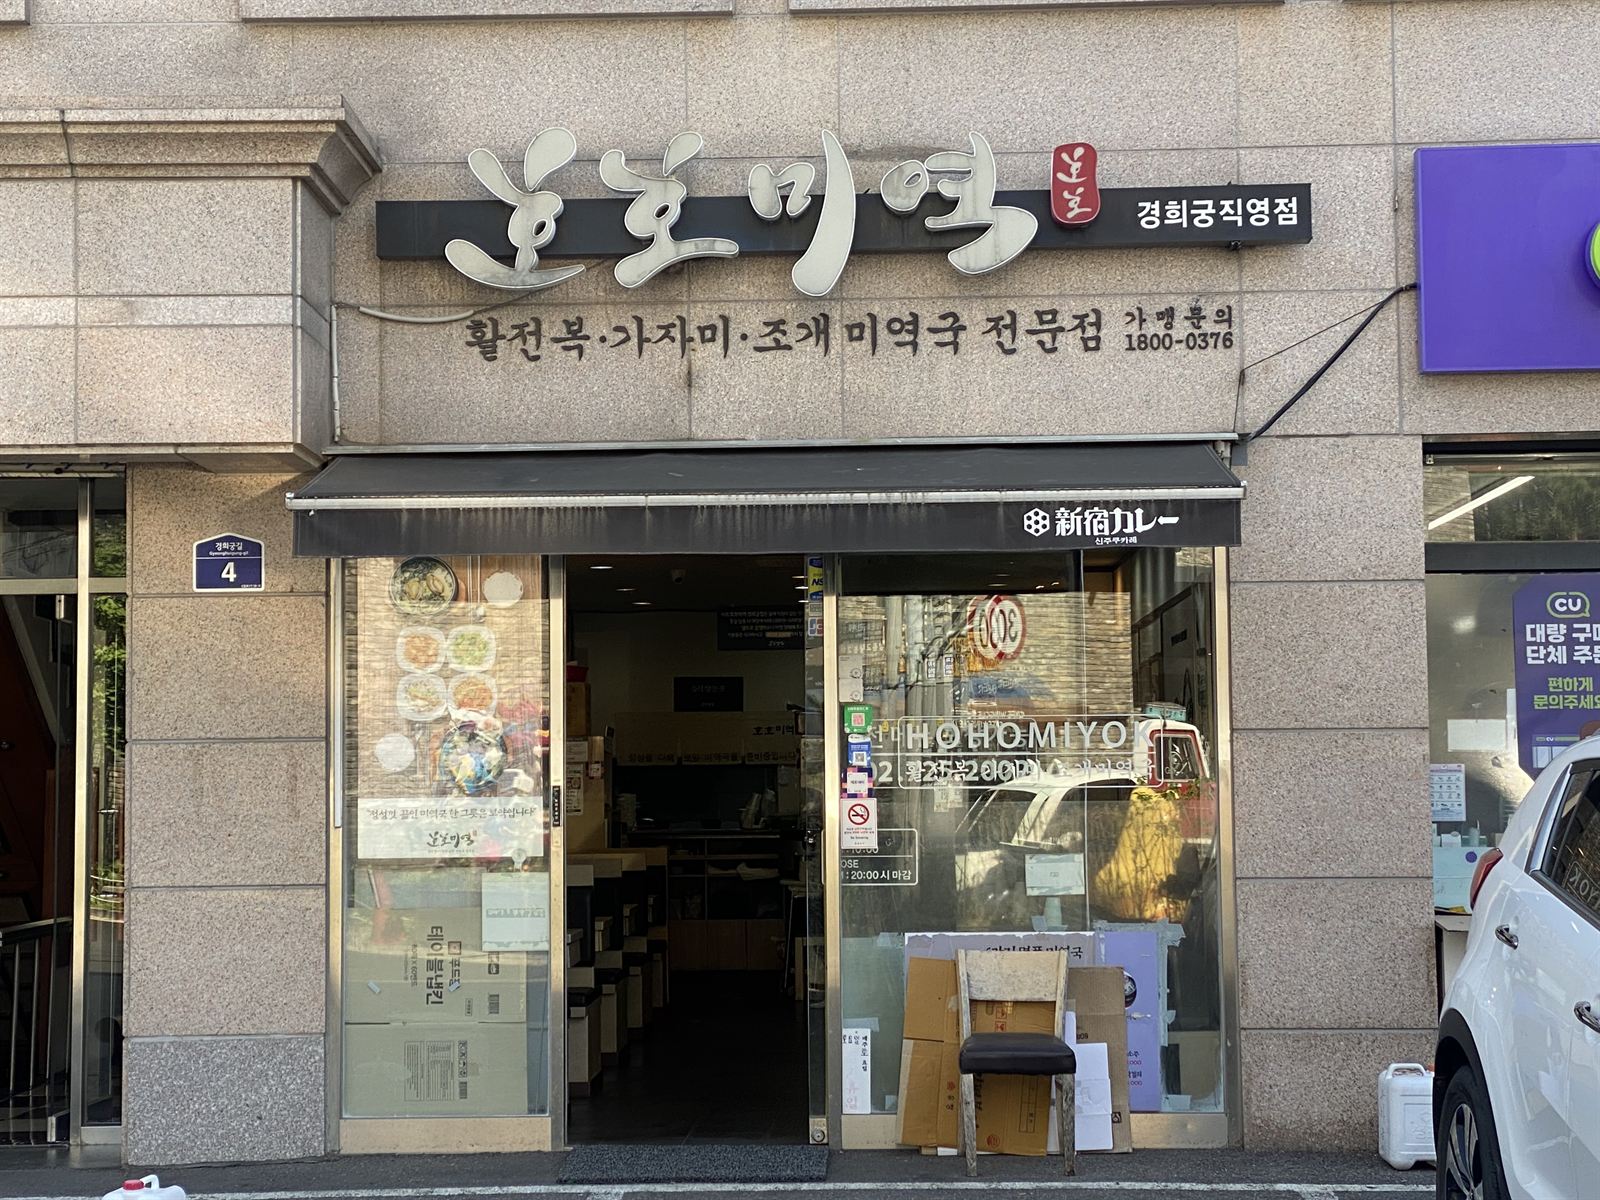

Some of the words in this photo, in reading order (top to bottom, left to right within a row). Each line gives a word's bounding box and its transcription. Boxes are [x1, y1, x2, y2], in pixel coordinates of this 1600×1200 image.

[445, 128, 1039, 296] 호호미역
[1137, 197, 1298, 230] 경희궁직영점
[981, 308, 1102, 356] 전문점
[1125, 331, 1234, 351] 1800-0376
[1055, 506, 1180, 537] 新宿カレー
[215, 541, 243, 551] 경희궁길
[1095, 536, 1138, 546] 신주쿠카레
[221, 561, 237, 583] 4
[1554, 598, 1582, 612] CU
[1525, 623, 1568, 644] 대량
[1526, 645, 1568, 665] 단체
[1548, 677, 1593, 692] 편하게
[906, 720, 1155, 750] HOHOMIYOK
[892, 870, 912, 880] 마감
[426, 926, 444, 1005] 테이블냅킨
